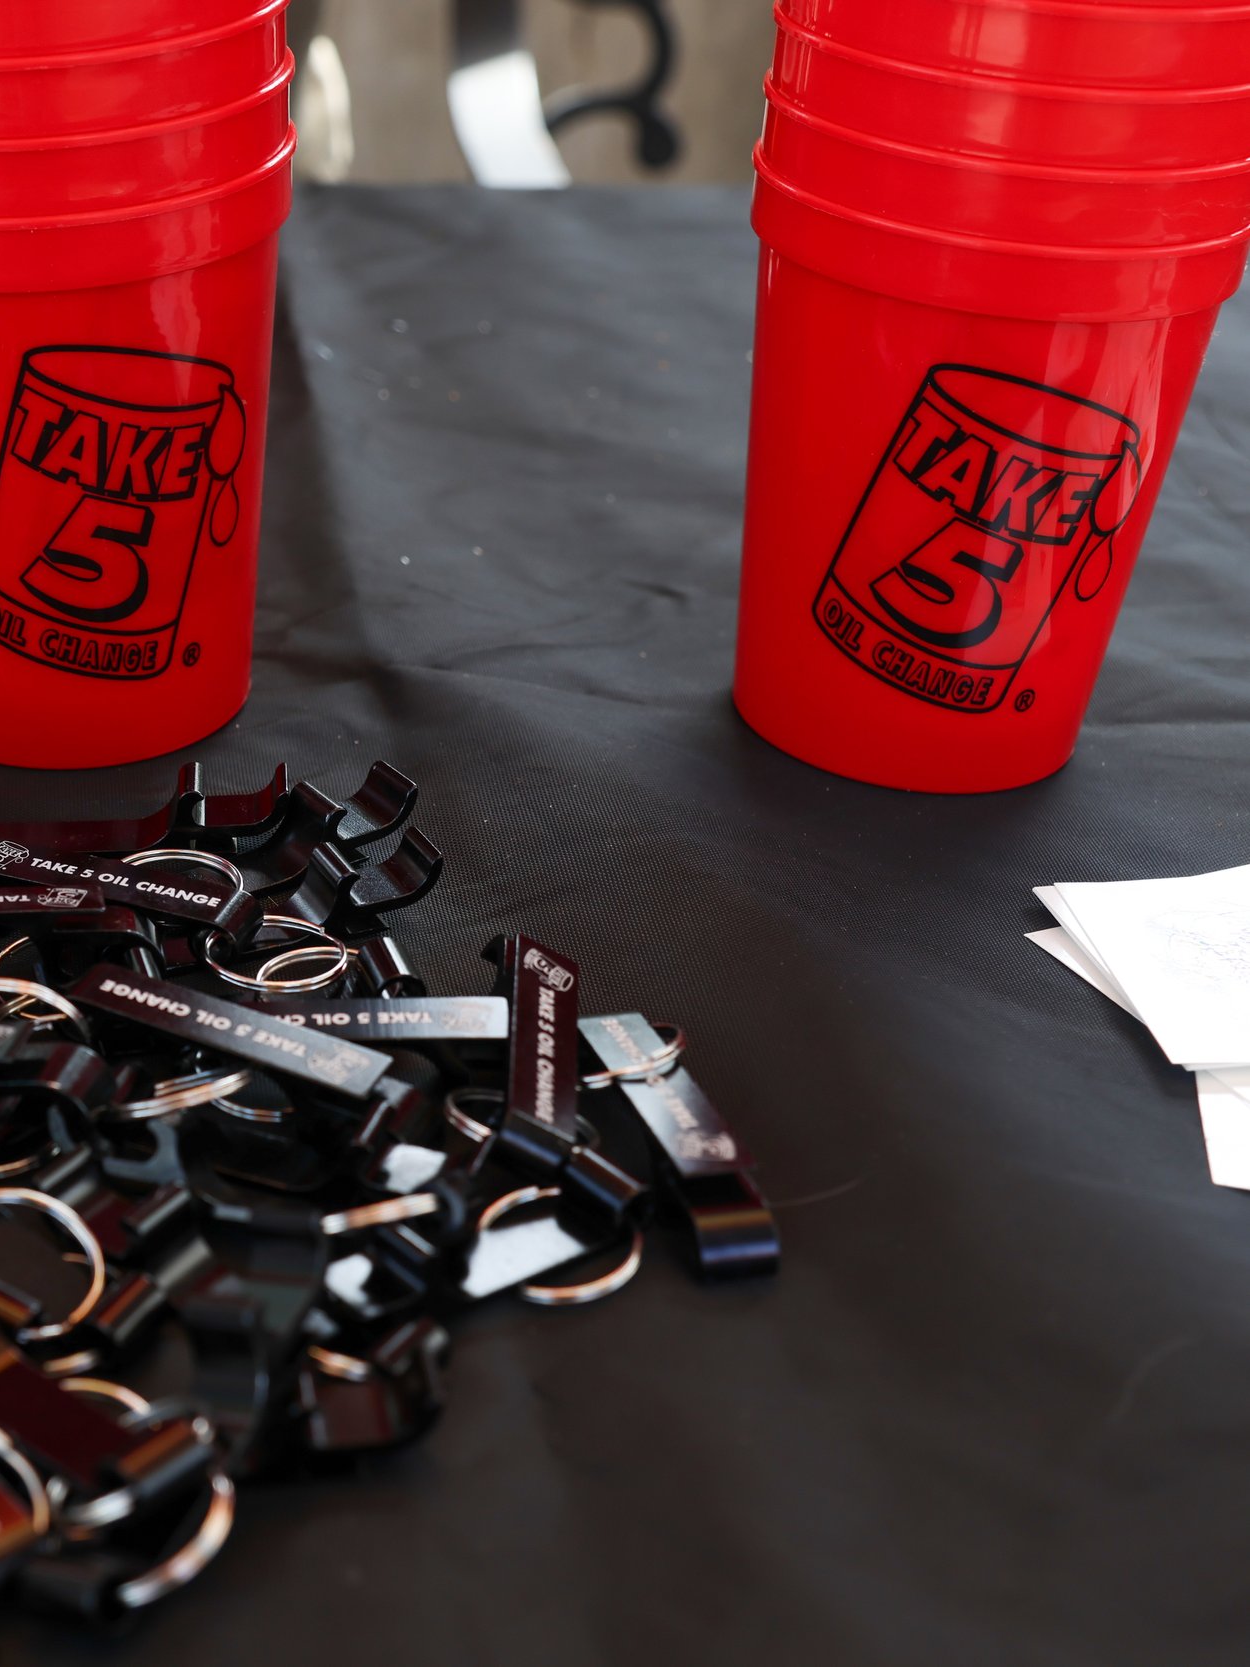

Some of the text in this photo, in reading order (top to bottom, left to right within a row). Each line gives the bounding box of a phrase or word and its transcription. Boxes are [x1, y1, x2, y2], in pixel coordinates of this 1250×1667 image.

[11, 385, 210, 503] TAKE
[893, 397, 1103, 546] TAKE
[19, 494, 155, 623] 5
[869, 517, 1025, 649] 5
[38, 628, 159, 672] CHANGE
[823, 598, 994, 706] OIL CHANGE
[30, 857, 222, 908] TAKE 5 OIL CHANGE
[99, 979, 306, 1057] TAKE 5 OIL CHANGE
[311, 1012, 352, 1025] OIL
[357, 1011, 370, 1024] 5
[377, 1011, 433, 1024] TAKE
